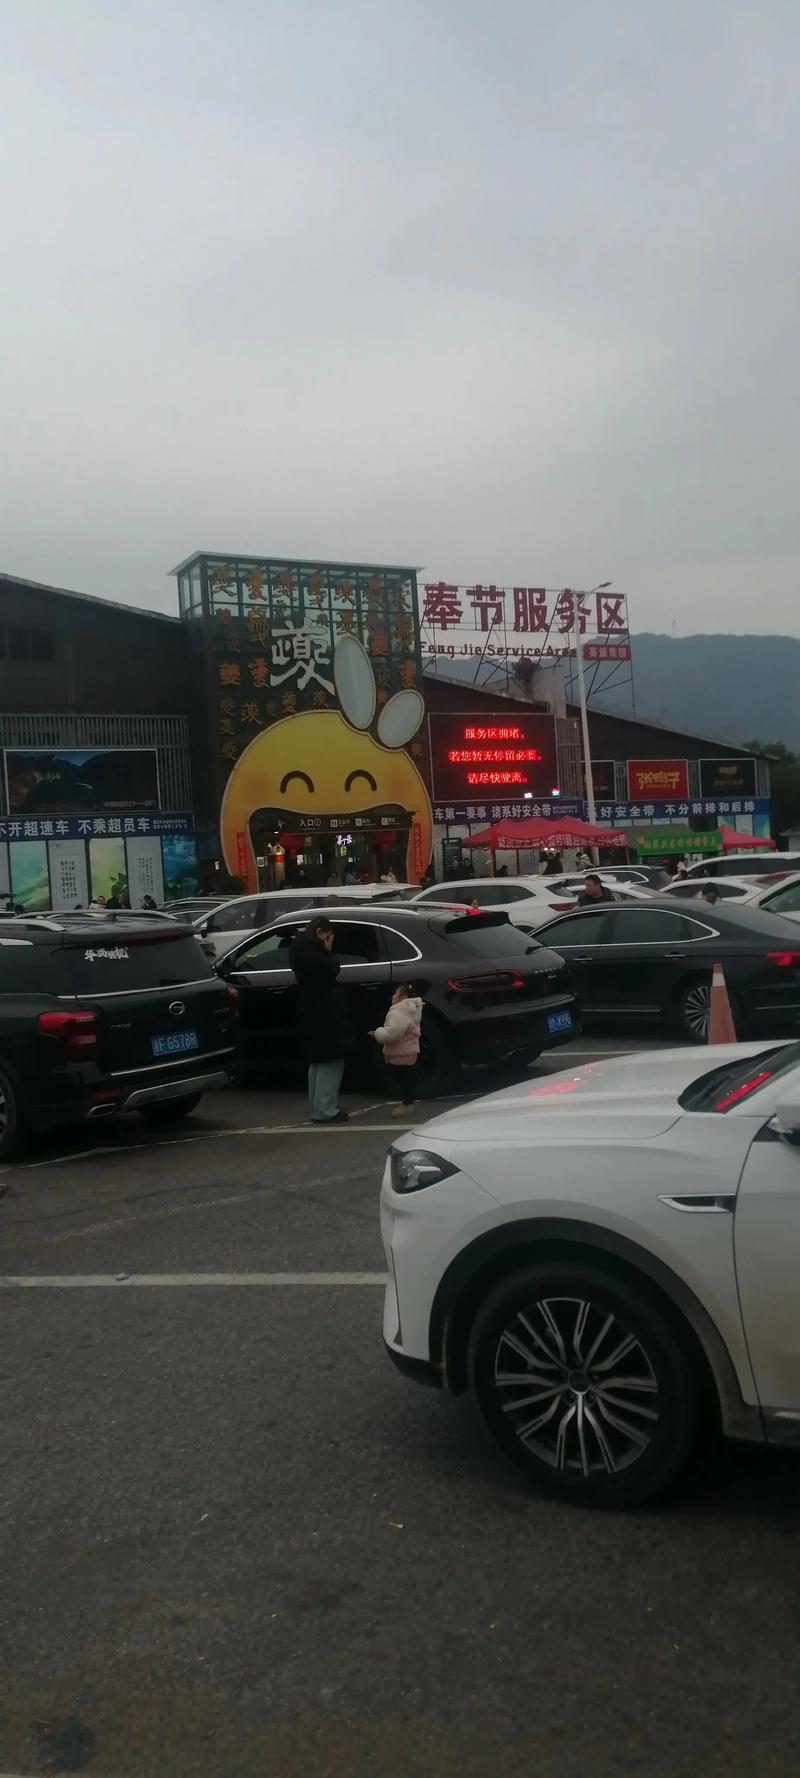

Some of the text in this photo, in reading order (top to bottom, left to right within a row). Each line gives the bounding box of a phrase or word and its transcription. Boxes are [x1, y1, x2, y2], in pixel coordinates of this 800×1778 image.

[423, 582, 629, 634] 奉节服务区
[460, 644, 482, 656] Jie
[487, 645, 541, 657] Service
[492, 804, 551, 818] 请系好安全带
[665, 801, 755, 815] 不分前排和后排
[78, 818, 150, 834] 不乘超员车
